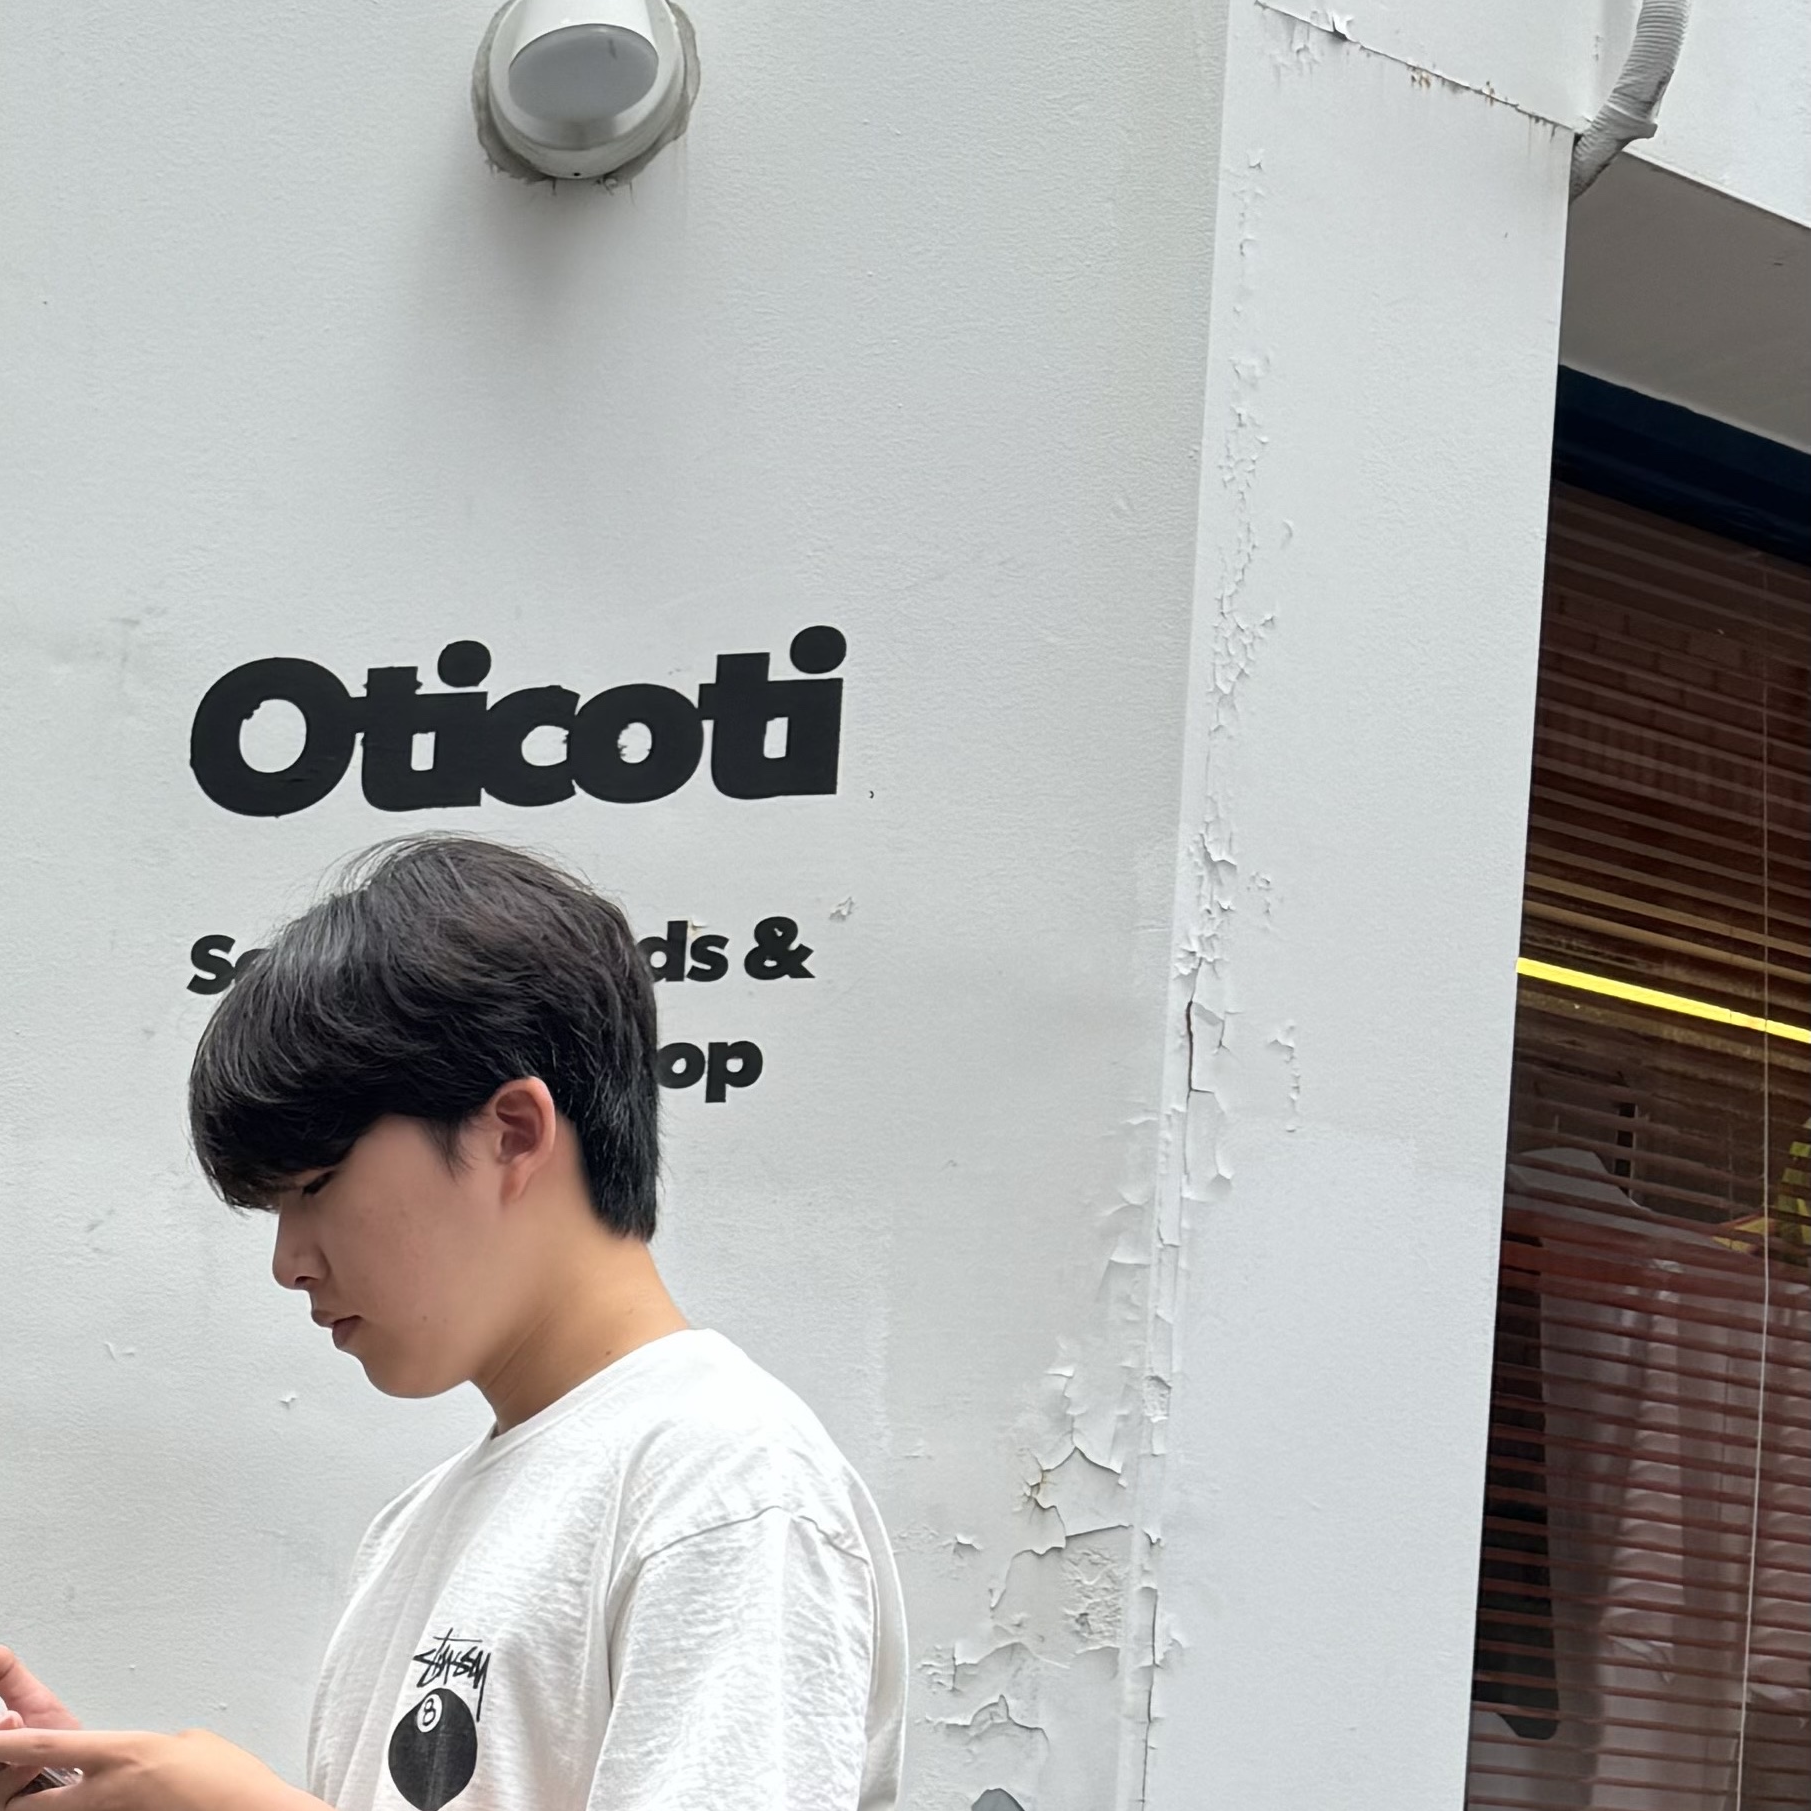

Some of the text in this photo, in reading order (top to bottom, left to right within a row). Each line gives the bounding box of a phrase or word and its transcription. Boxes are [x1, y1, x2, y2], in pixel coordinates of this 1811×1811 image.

[190, 625, 847, 817] Oticoti
[744, 916, 816, 981] &
[656, 1041, 763, 1103] op
[422, 1698, 436, 1726] 8
